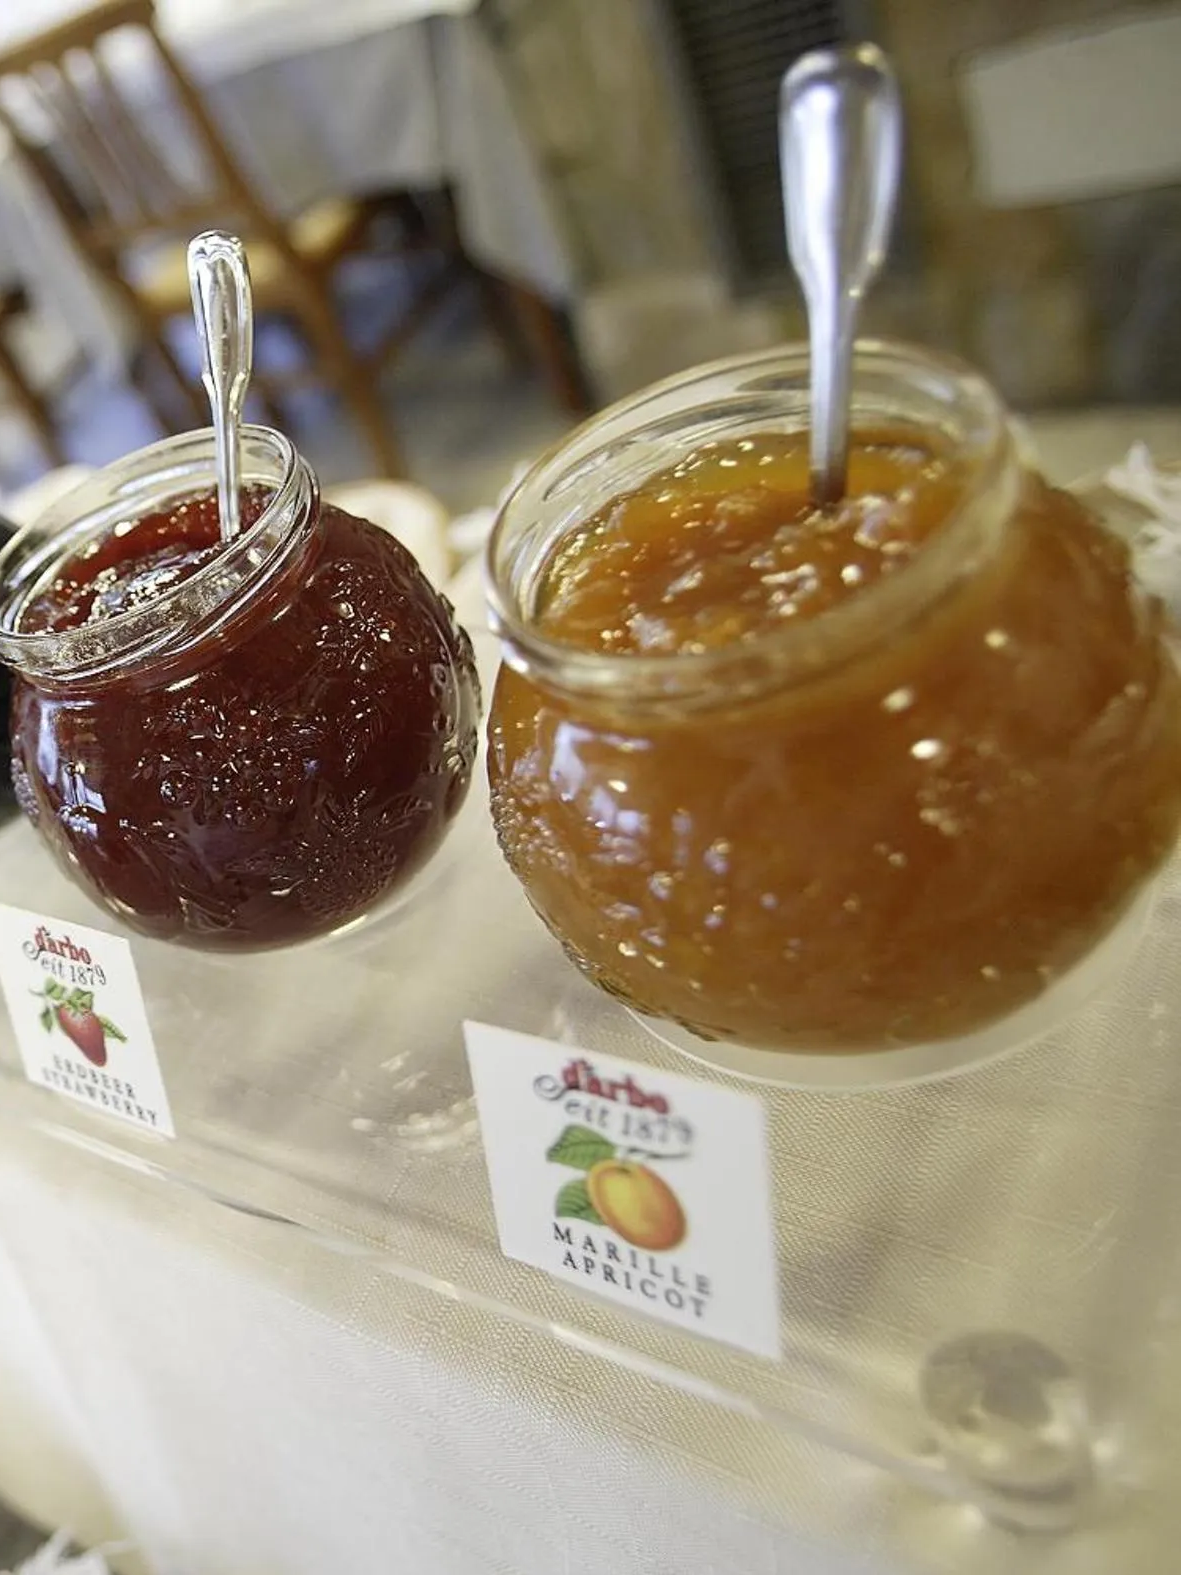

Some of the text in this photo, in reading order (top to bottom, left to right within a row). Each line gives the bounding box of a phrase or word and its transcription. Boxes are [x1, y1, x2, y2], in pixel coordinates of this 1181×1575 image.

[70, 964, 107, 986] 1879
[42, 1065, 157, 1128] STRAWBERRY
[52, 1054, 136, 1100] ERDBEER
[622, 1113, 695, 1146] 1879
[552, 1221, 713, 1297] MARILLE
[562, 1250, 706, 1319] APRICOT
